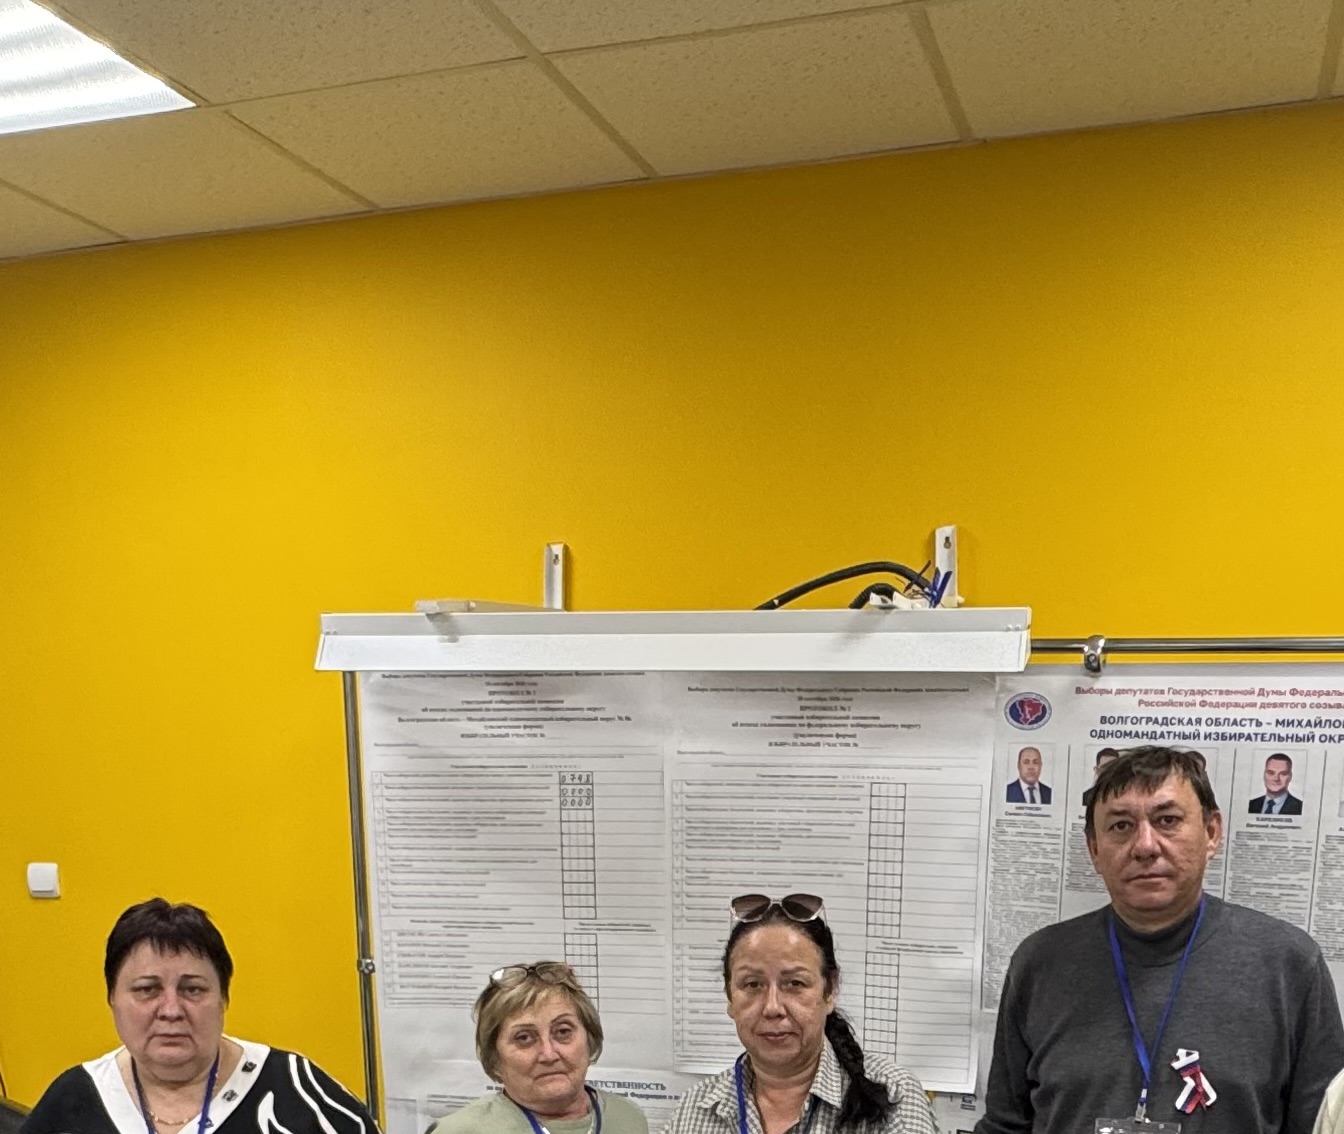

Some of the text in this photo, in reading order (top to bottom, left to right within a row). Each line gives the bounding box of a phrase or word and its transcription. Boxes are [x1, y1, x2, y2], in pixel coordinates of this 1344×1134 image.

[1075, 687, 1112, 697] Выборы
[1114, 688, 1165, 697] депутатов
[1168, 687, 1255, 697] Государственной
[1257, 688, 1286, 697] Думы
[1138, 699, 1196, 708] Российской
[1199, 700, 1257, 709] Федерации
[1259, 701, 1306, 710] девятого
[1100, 716, 1202, 727] ВОЛГОГРАДСКАЯ
[1205, 717, 1263, 728] ОБЛАСТЬ
[1090, 729, 1200, 741] ОДНОМАНДАТНЫЙ
[1204, 731, 1314, 743] ИЗБИРАТЕЛЬНЫЙ
